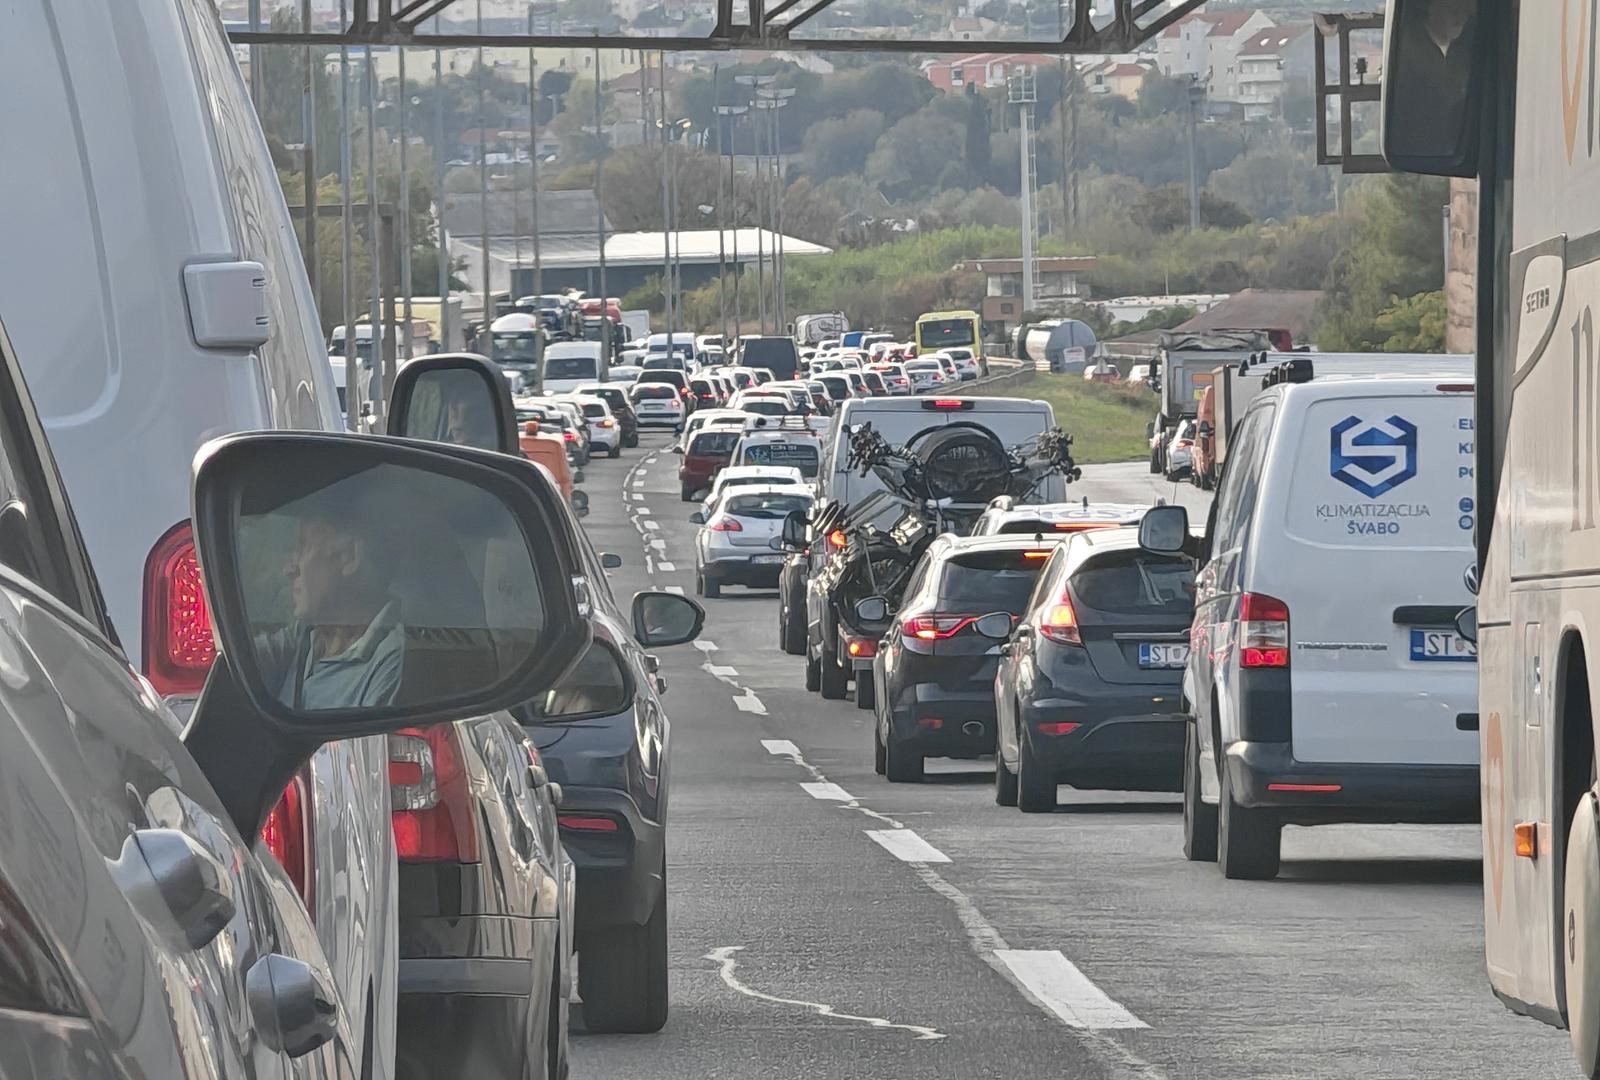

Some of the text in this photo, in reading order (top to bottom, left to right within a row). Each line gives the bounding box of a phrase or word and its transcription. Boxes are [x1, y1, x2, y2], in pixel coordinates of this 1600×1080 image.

[1316, 503, 1431, 518] KLIMATIZACIJA
[1347, 519, 1400, 535] ŠVABO
[1427, 633, 1453, 655] ST
[1151, 645, 1171, 662] ST
